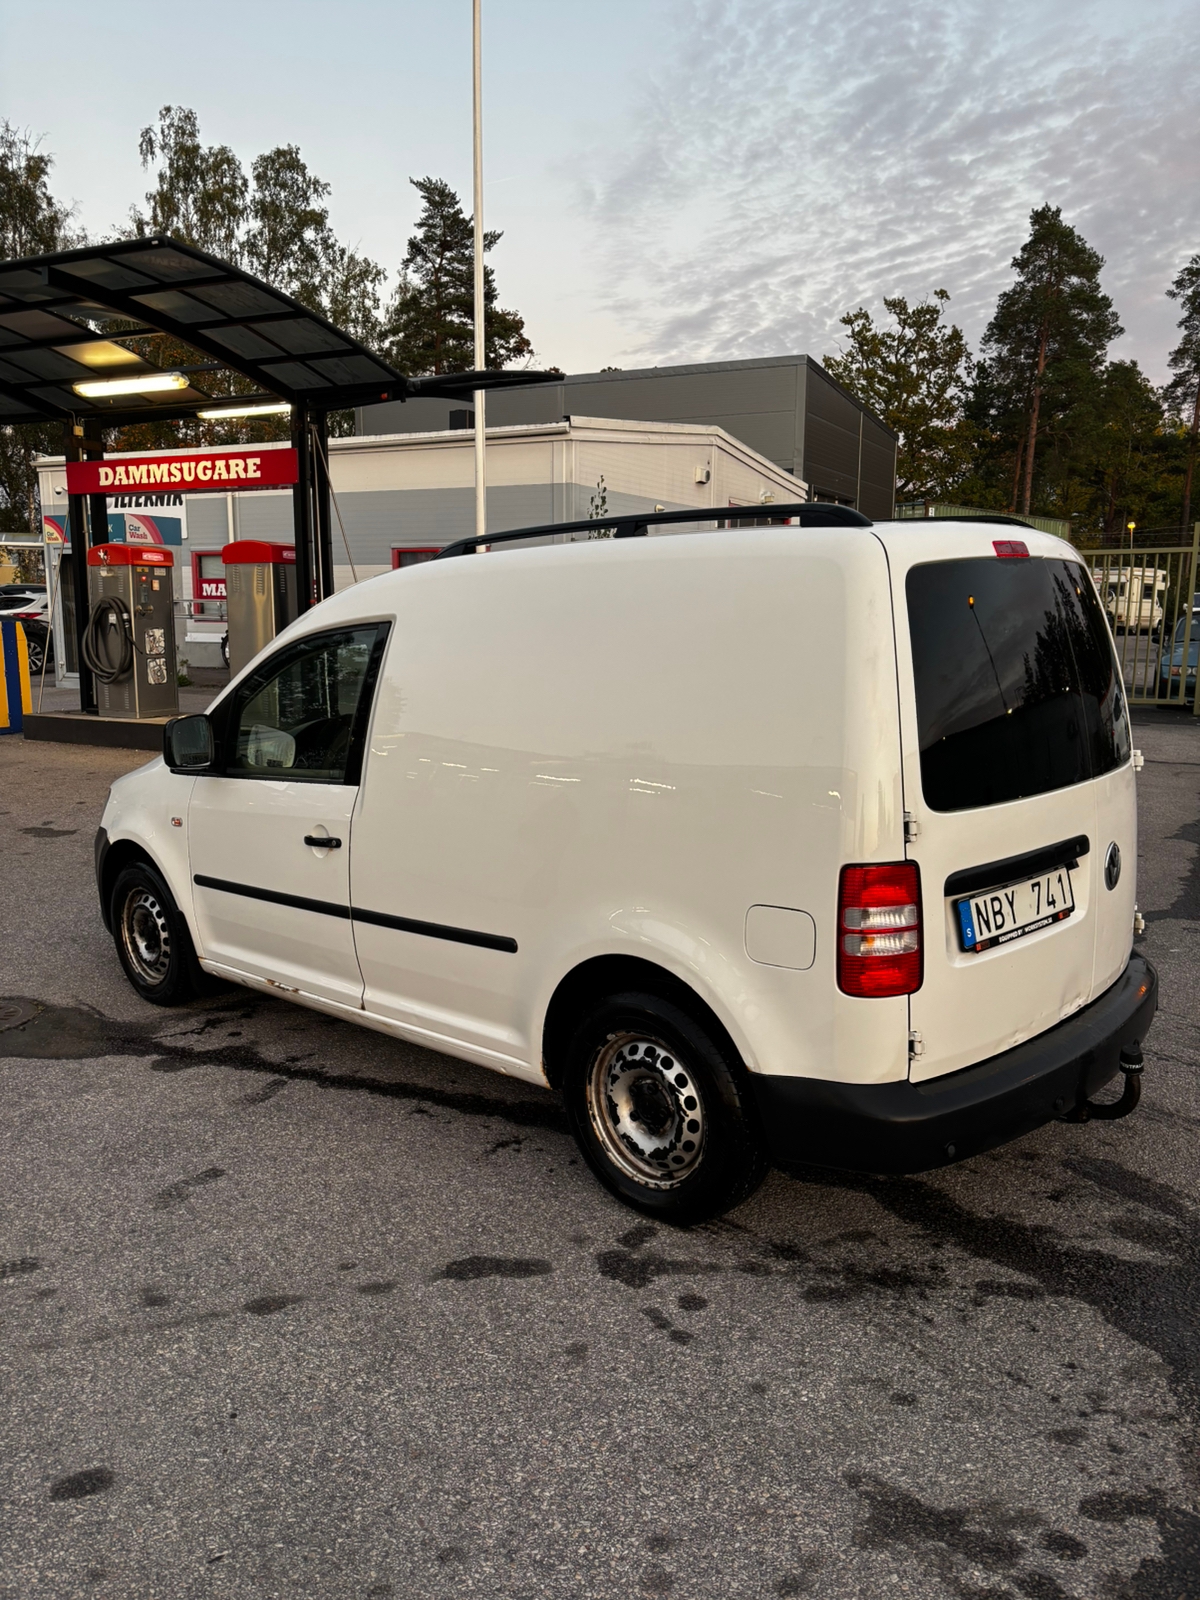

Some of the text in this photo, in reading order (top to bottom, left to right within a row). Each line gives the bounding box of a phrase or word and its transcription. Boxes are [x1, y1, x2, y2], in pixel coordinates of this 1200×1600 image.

[98, 457, 261, 486] DAMMSUGARE
[128, 524, 141, 532] Car
[975, 873, 1066, 937] NBY 741
[966, 928, 972, 938] S
